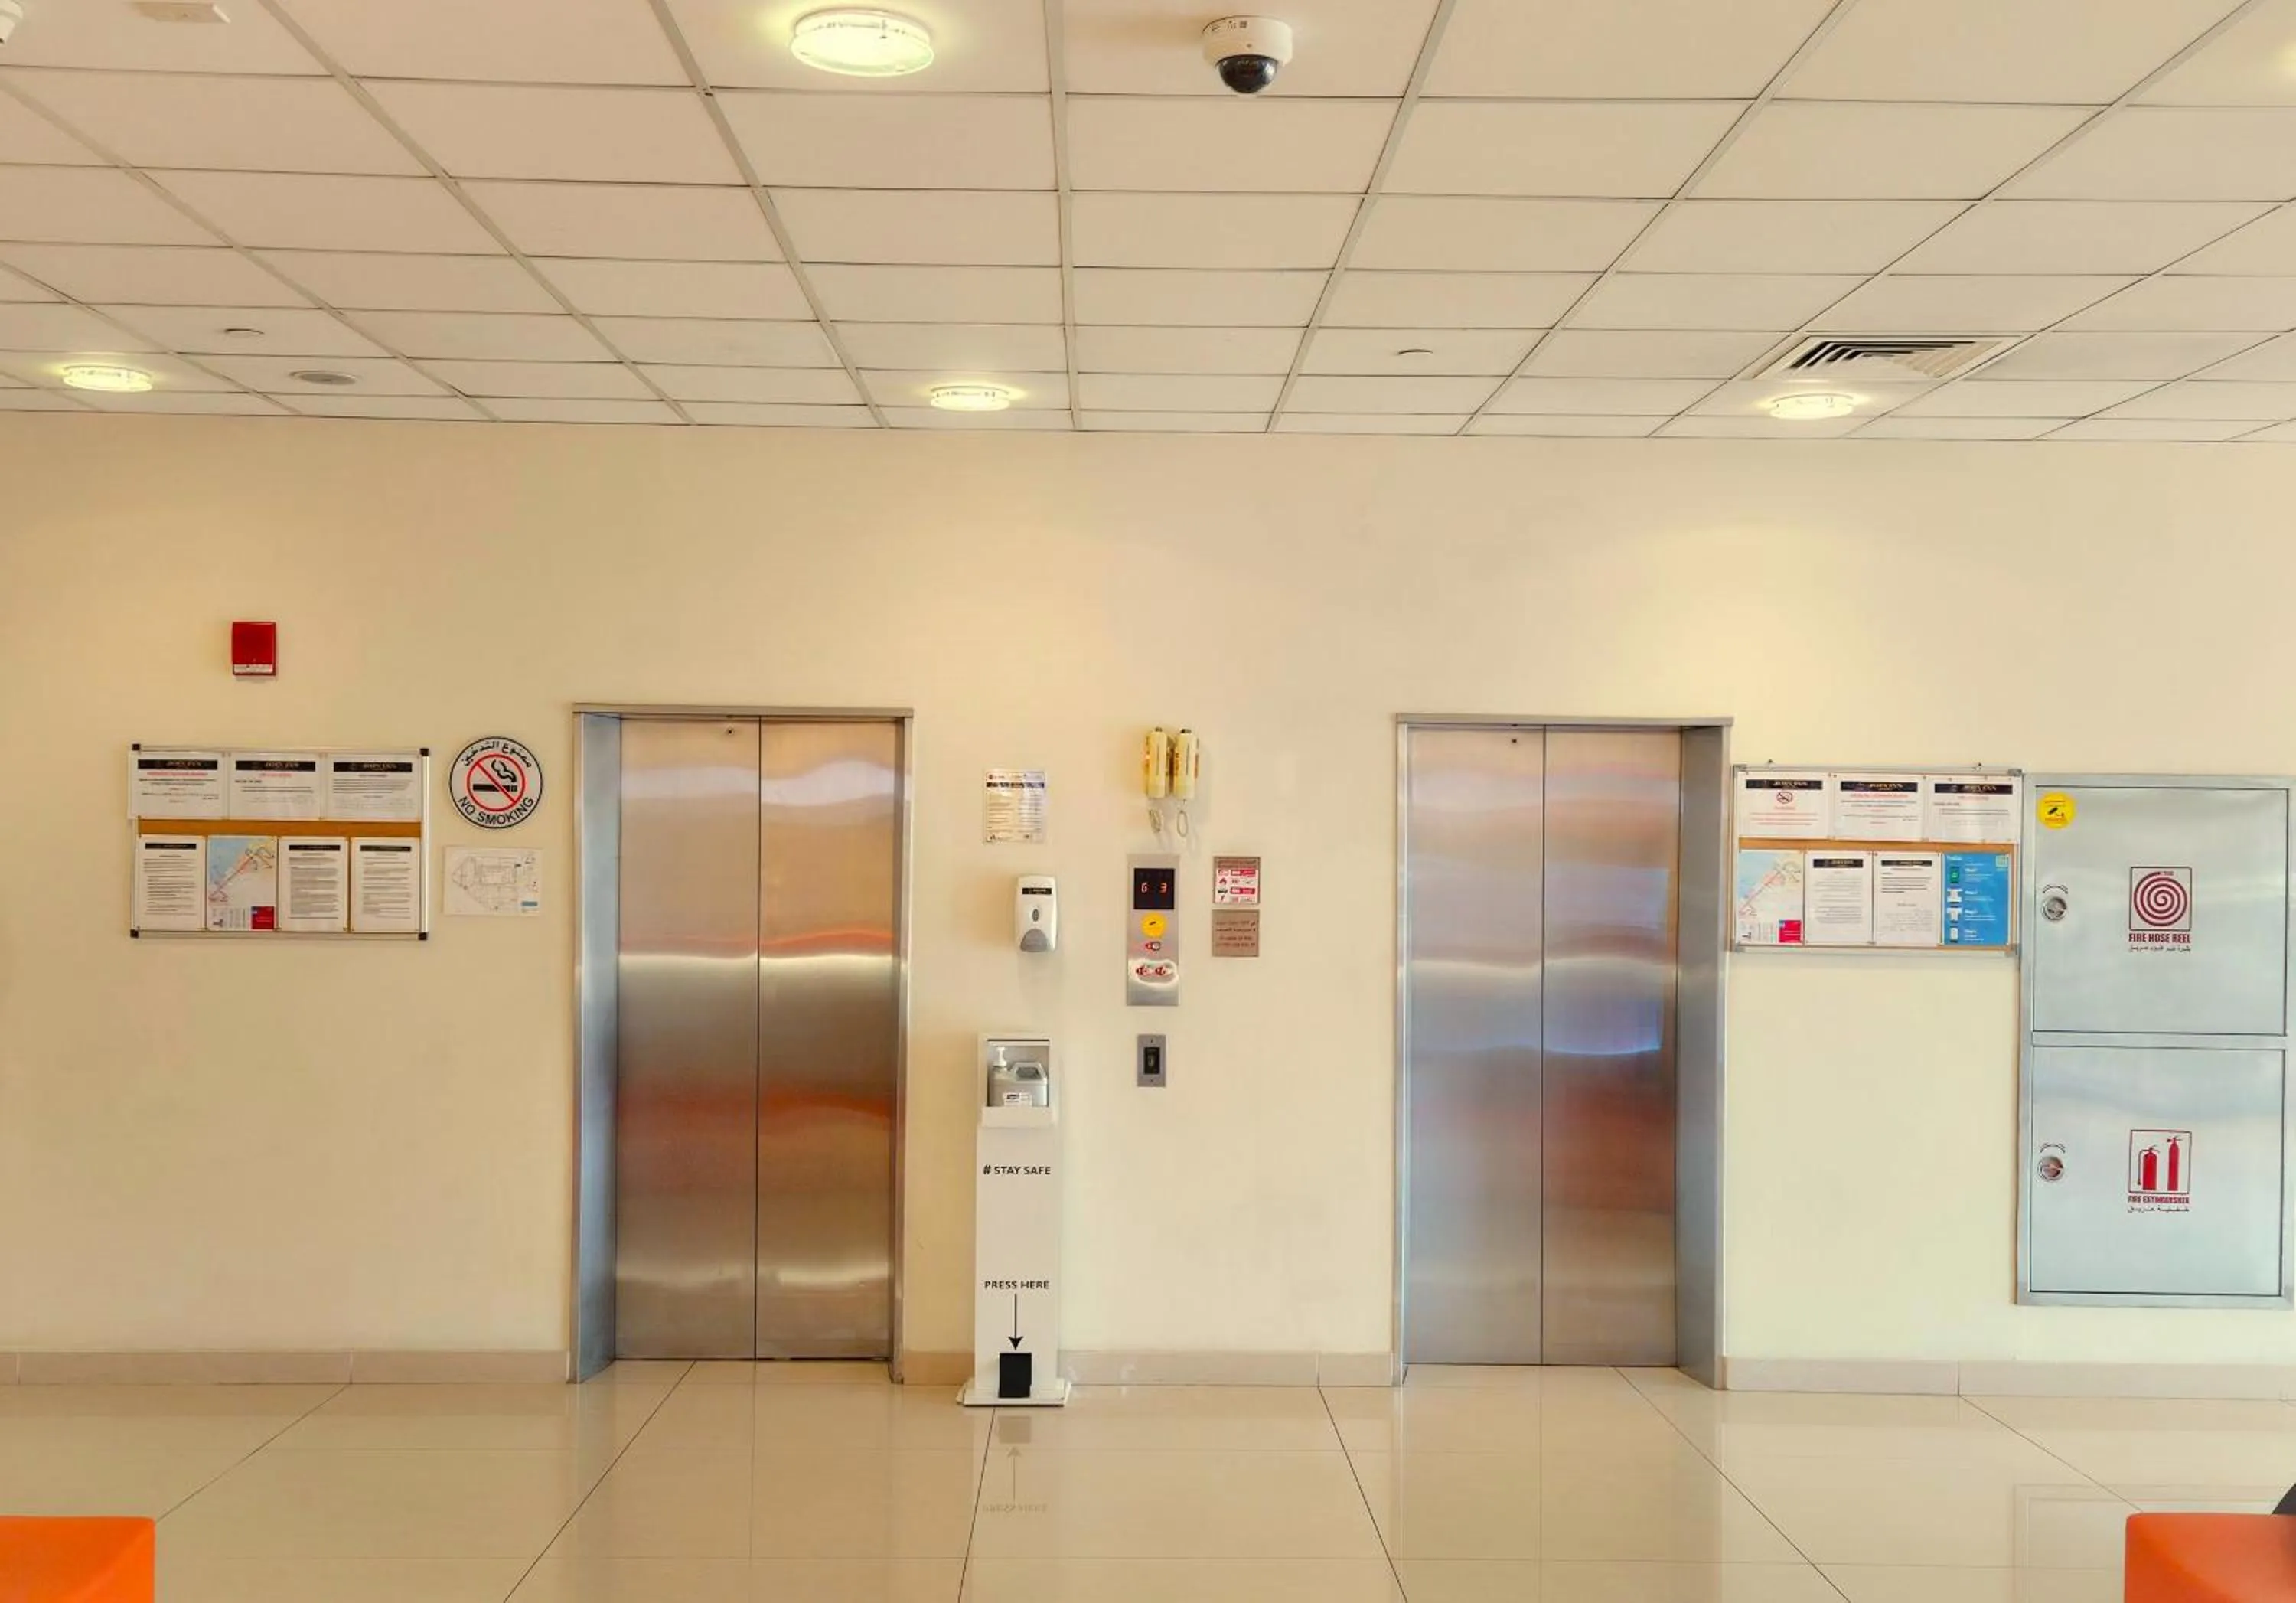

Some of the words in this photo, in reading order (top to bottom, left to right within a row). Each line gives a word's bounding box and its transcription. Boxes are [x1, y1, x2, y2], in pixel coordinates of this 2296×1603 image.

[458, 796, 476, 815] NO
[477, 797, 534, 824] SMOKING
[2128, 933, 2147, 942] FIRE
[2148, 933, 2170, 943] HOSE
[2172, 934, 2191, 944] REEL
[994, 1166, 1022, 1175] STAY
[1023, 1166, 1051, 1175] SAFE
[983, 1281, 1017, 1290] PRESS
[1020, 1281, 1050, 1290] HERE
